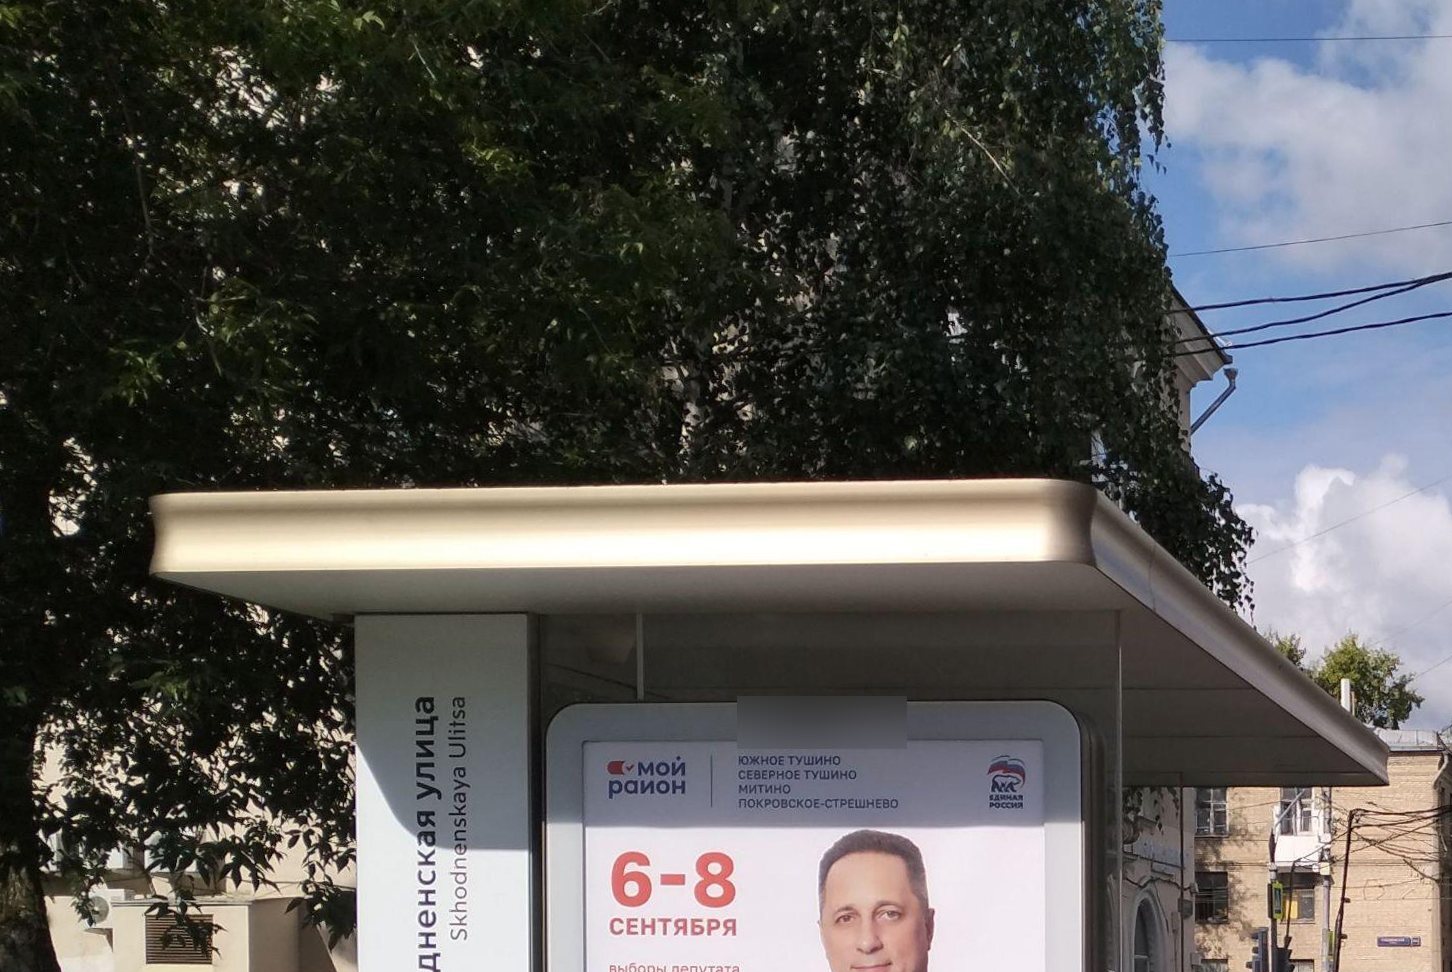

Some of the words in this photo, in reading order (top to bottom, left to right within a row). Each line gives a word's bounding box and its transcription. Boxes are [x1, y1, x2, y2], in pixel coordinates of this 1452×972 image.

[448, 697, 466, 758] Ulitsa
[415, 696, 442, 800] улица
[638, 756, 686, 777] мой
[738, 755, 785, 766] ЮЖНОЕ
[788, 755, 841, 766] ТУШИНО
[738, 769, 801, 780] СЕВЕРНОЕ
[804, 769, 857, 780] ТУШИНО
[608, 780, 686, 799] район
[738, 784, 791, 795] МИТИНО
[738, 798, 899, 809] ПОКРОВСКОЕ-СТРЕШНЕВО
[448, 766, 471, 941] Skhodnenskaya
[609, 917, 737, 937] СЕНТЯБРЯ
